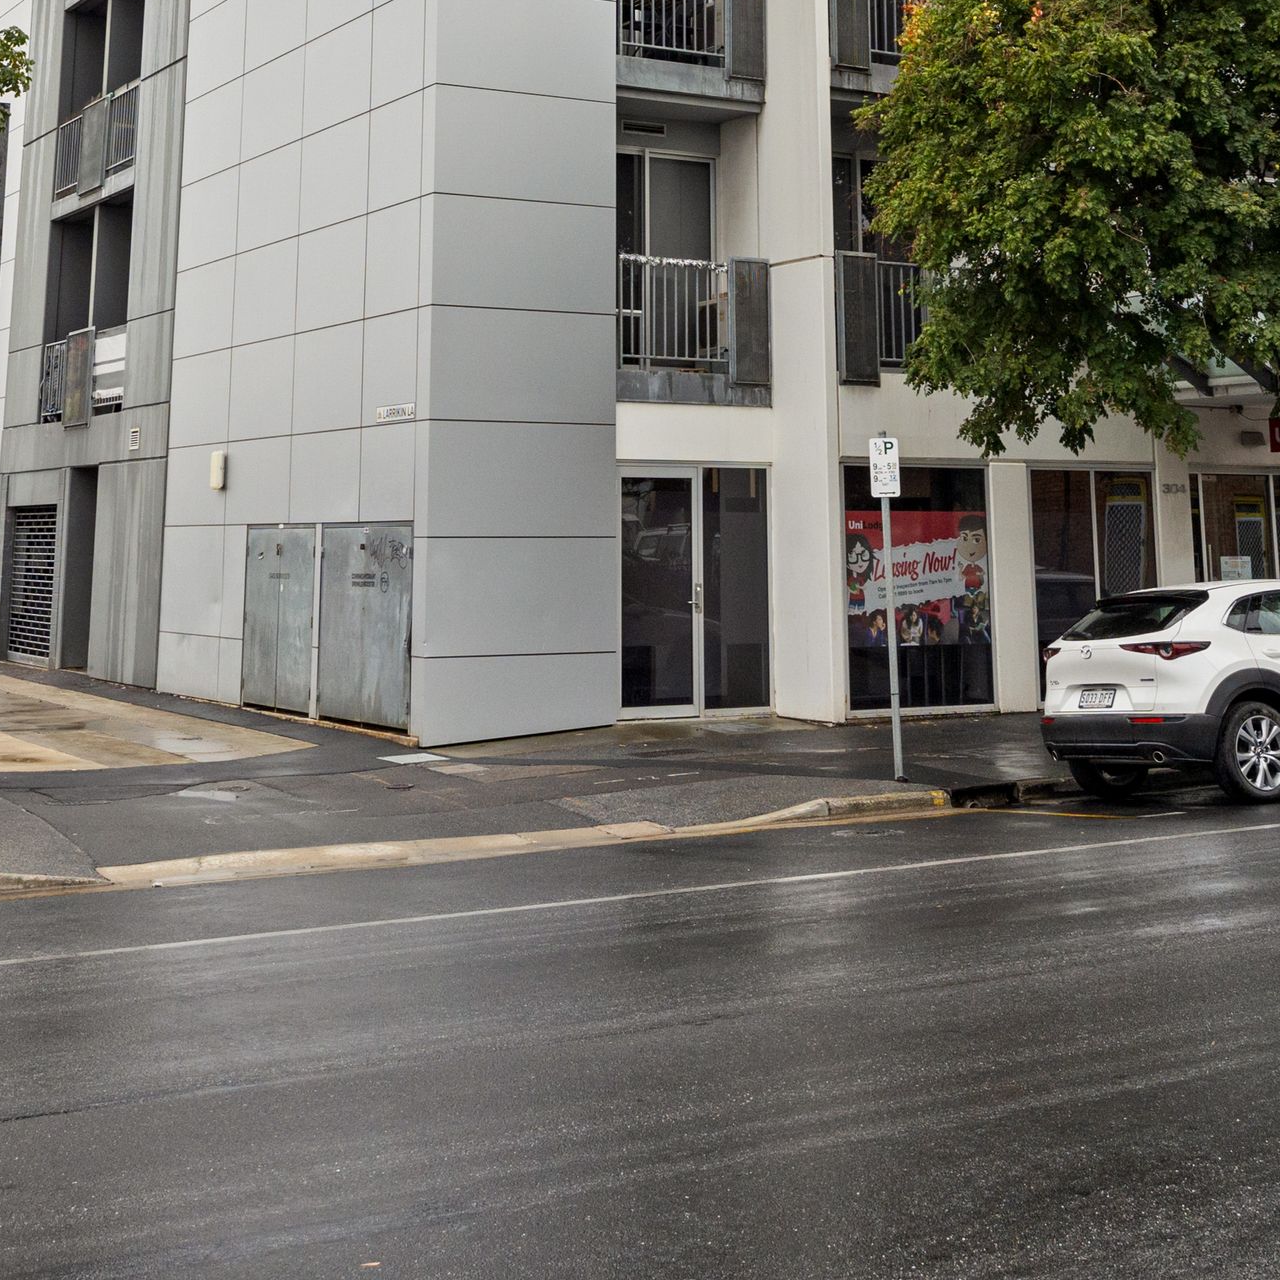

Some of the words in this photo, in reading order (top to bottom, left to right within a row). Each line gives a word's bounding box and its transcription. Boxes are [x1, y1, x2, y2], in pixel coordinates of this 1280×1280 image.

[383, 406, 407, 419] LARRIKIN
[407, 404, 415, 417] LA
[1162, 484, 1187, 494] 304
[848, 520, 883, 532] UniLodg
[922, 548, 958, 575] Now!
